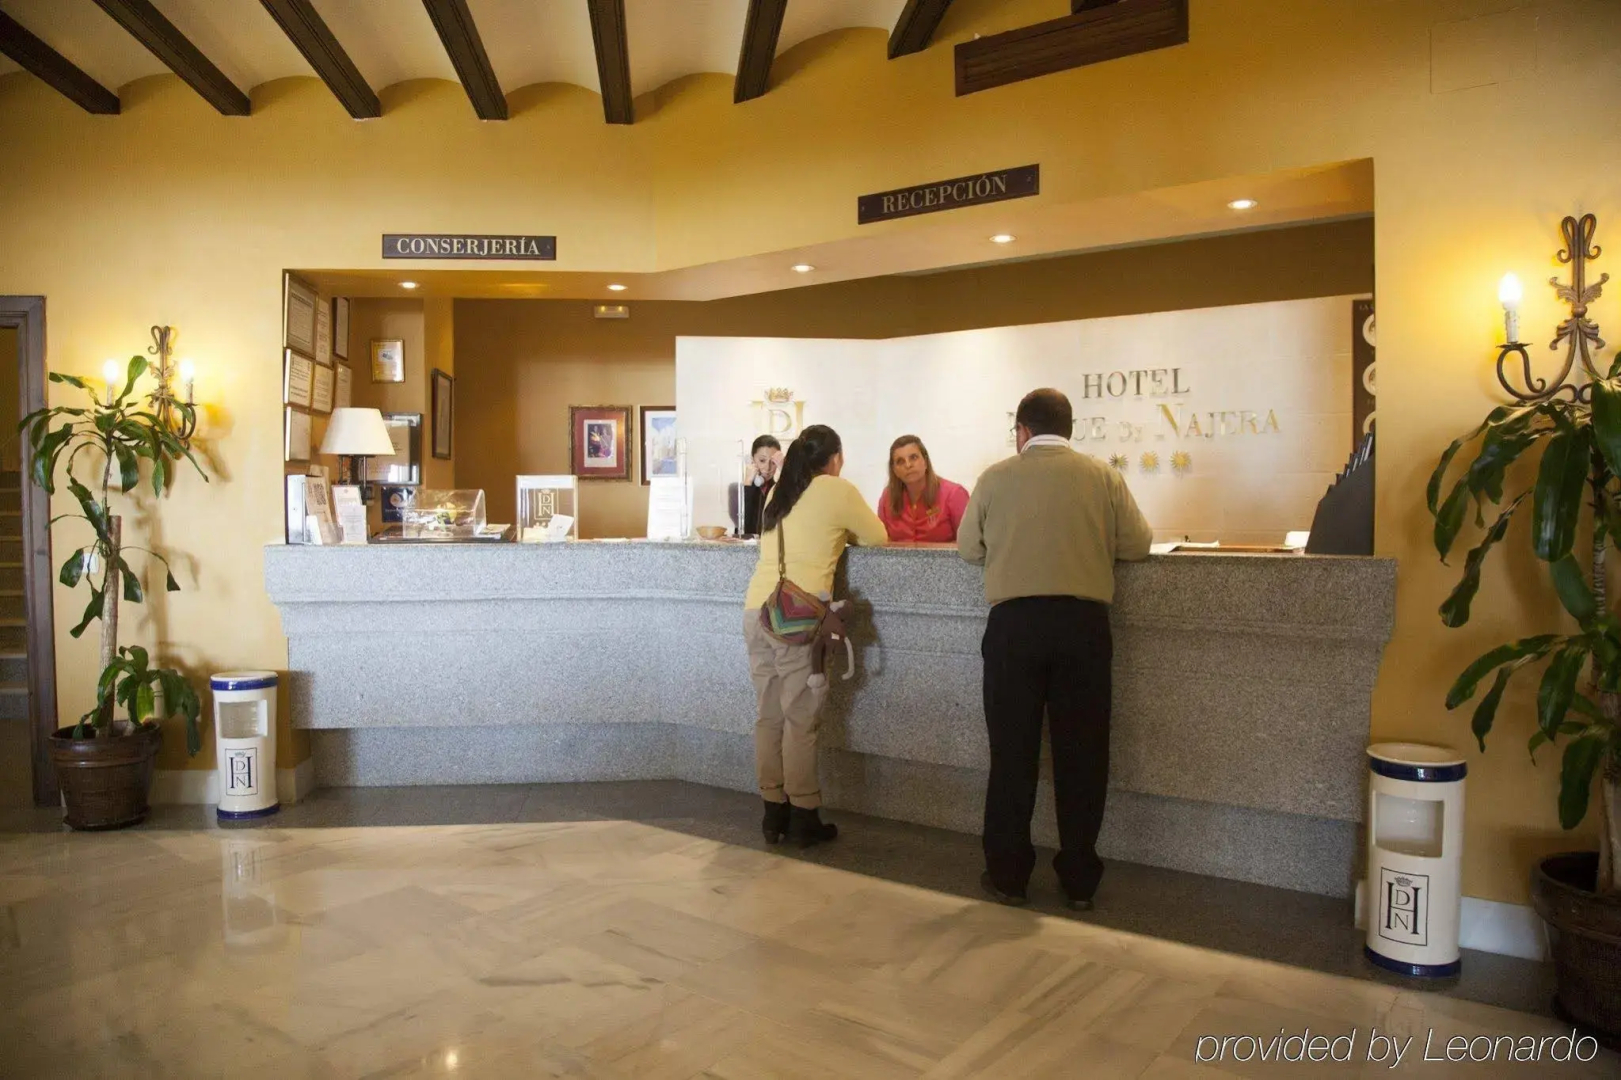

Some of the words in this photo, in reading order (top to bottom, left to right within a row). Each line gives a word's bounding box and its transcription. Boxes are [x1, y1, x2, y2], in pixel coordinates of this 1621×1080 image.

[881, 173, 1008, 214] RECEPCIÓN
[397, 236, 541, 256] CONSERJERÍA
[1081, 367, 1191, 399] HOTEL
[1154, 403, 1281, 439] NAJERA
